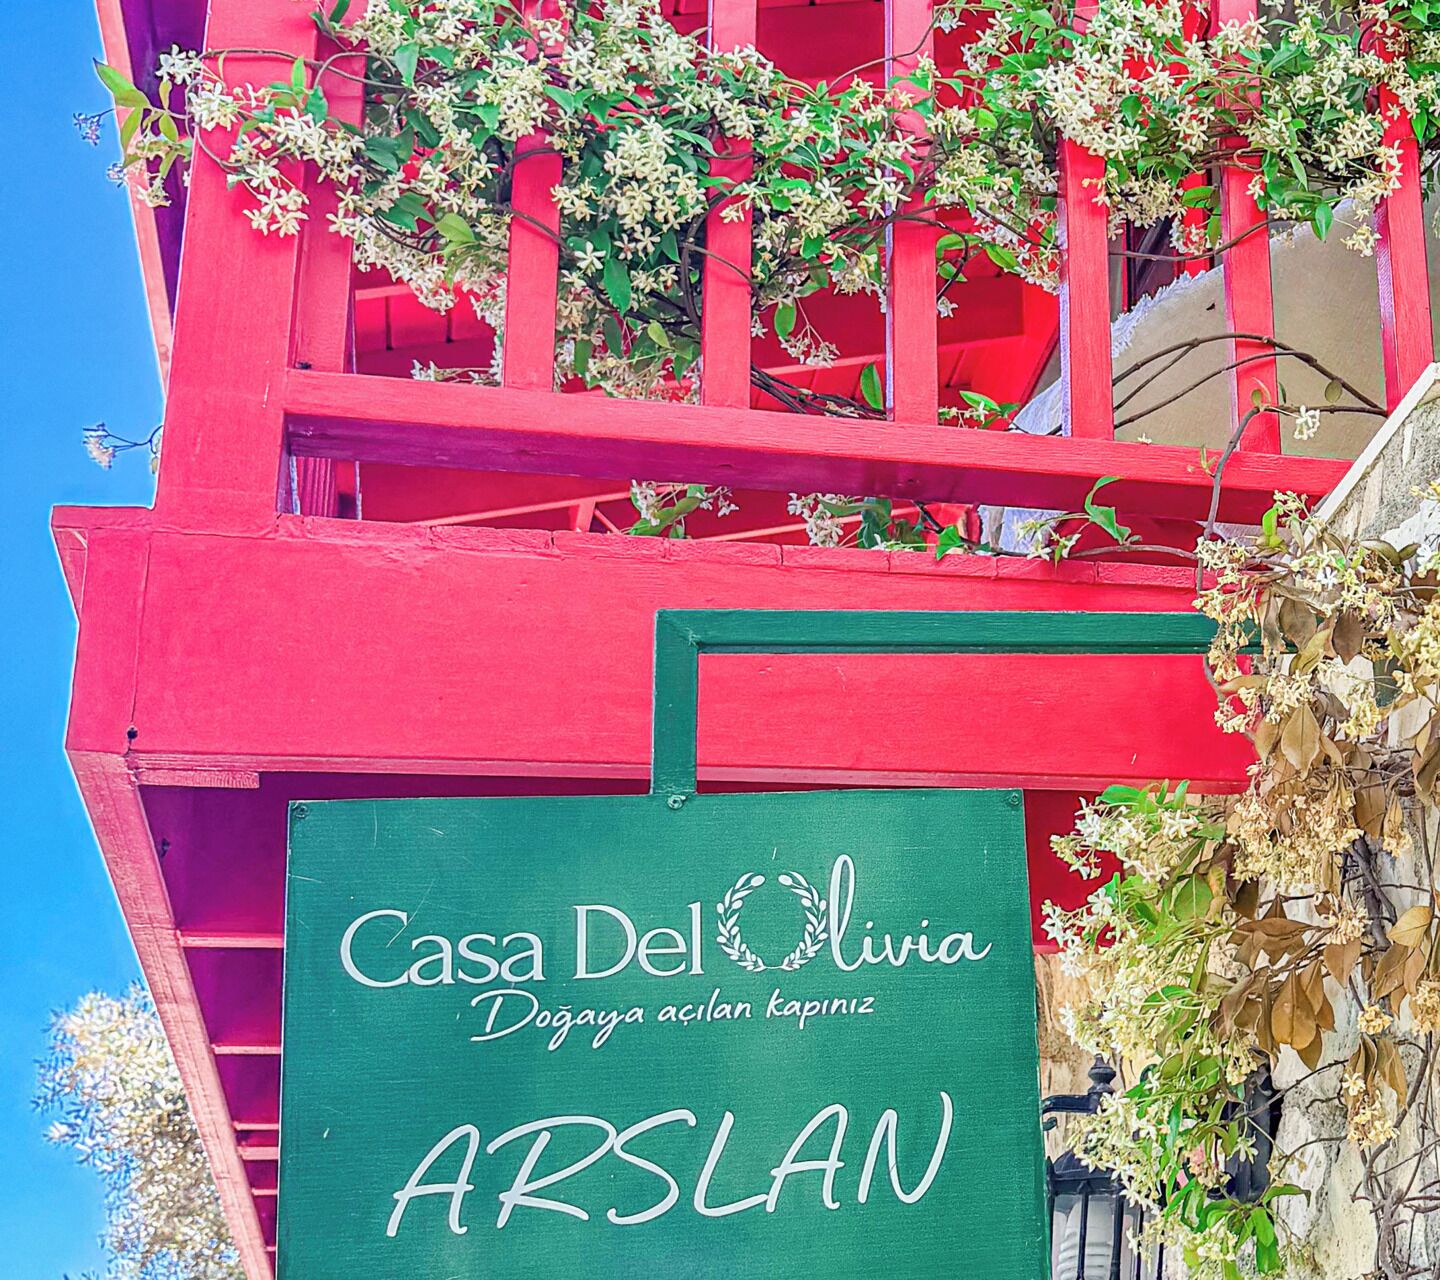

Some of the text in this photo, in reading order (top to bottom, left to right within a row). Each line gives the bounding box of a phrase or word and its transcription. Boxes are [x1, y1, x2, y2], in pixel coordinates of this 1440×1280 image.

[340, 908, 546, 987] Casa
[573, 901, 704, 980] Del
[470, 988, 876, 1051] Doğaya açılan kapınız
[385, 1090, 955, 1238] ARSLAN
